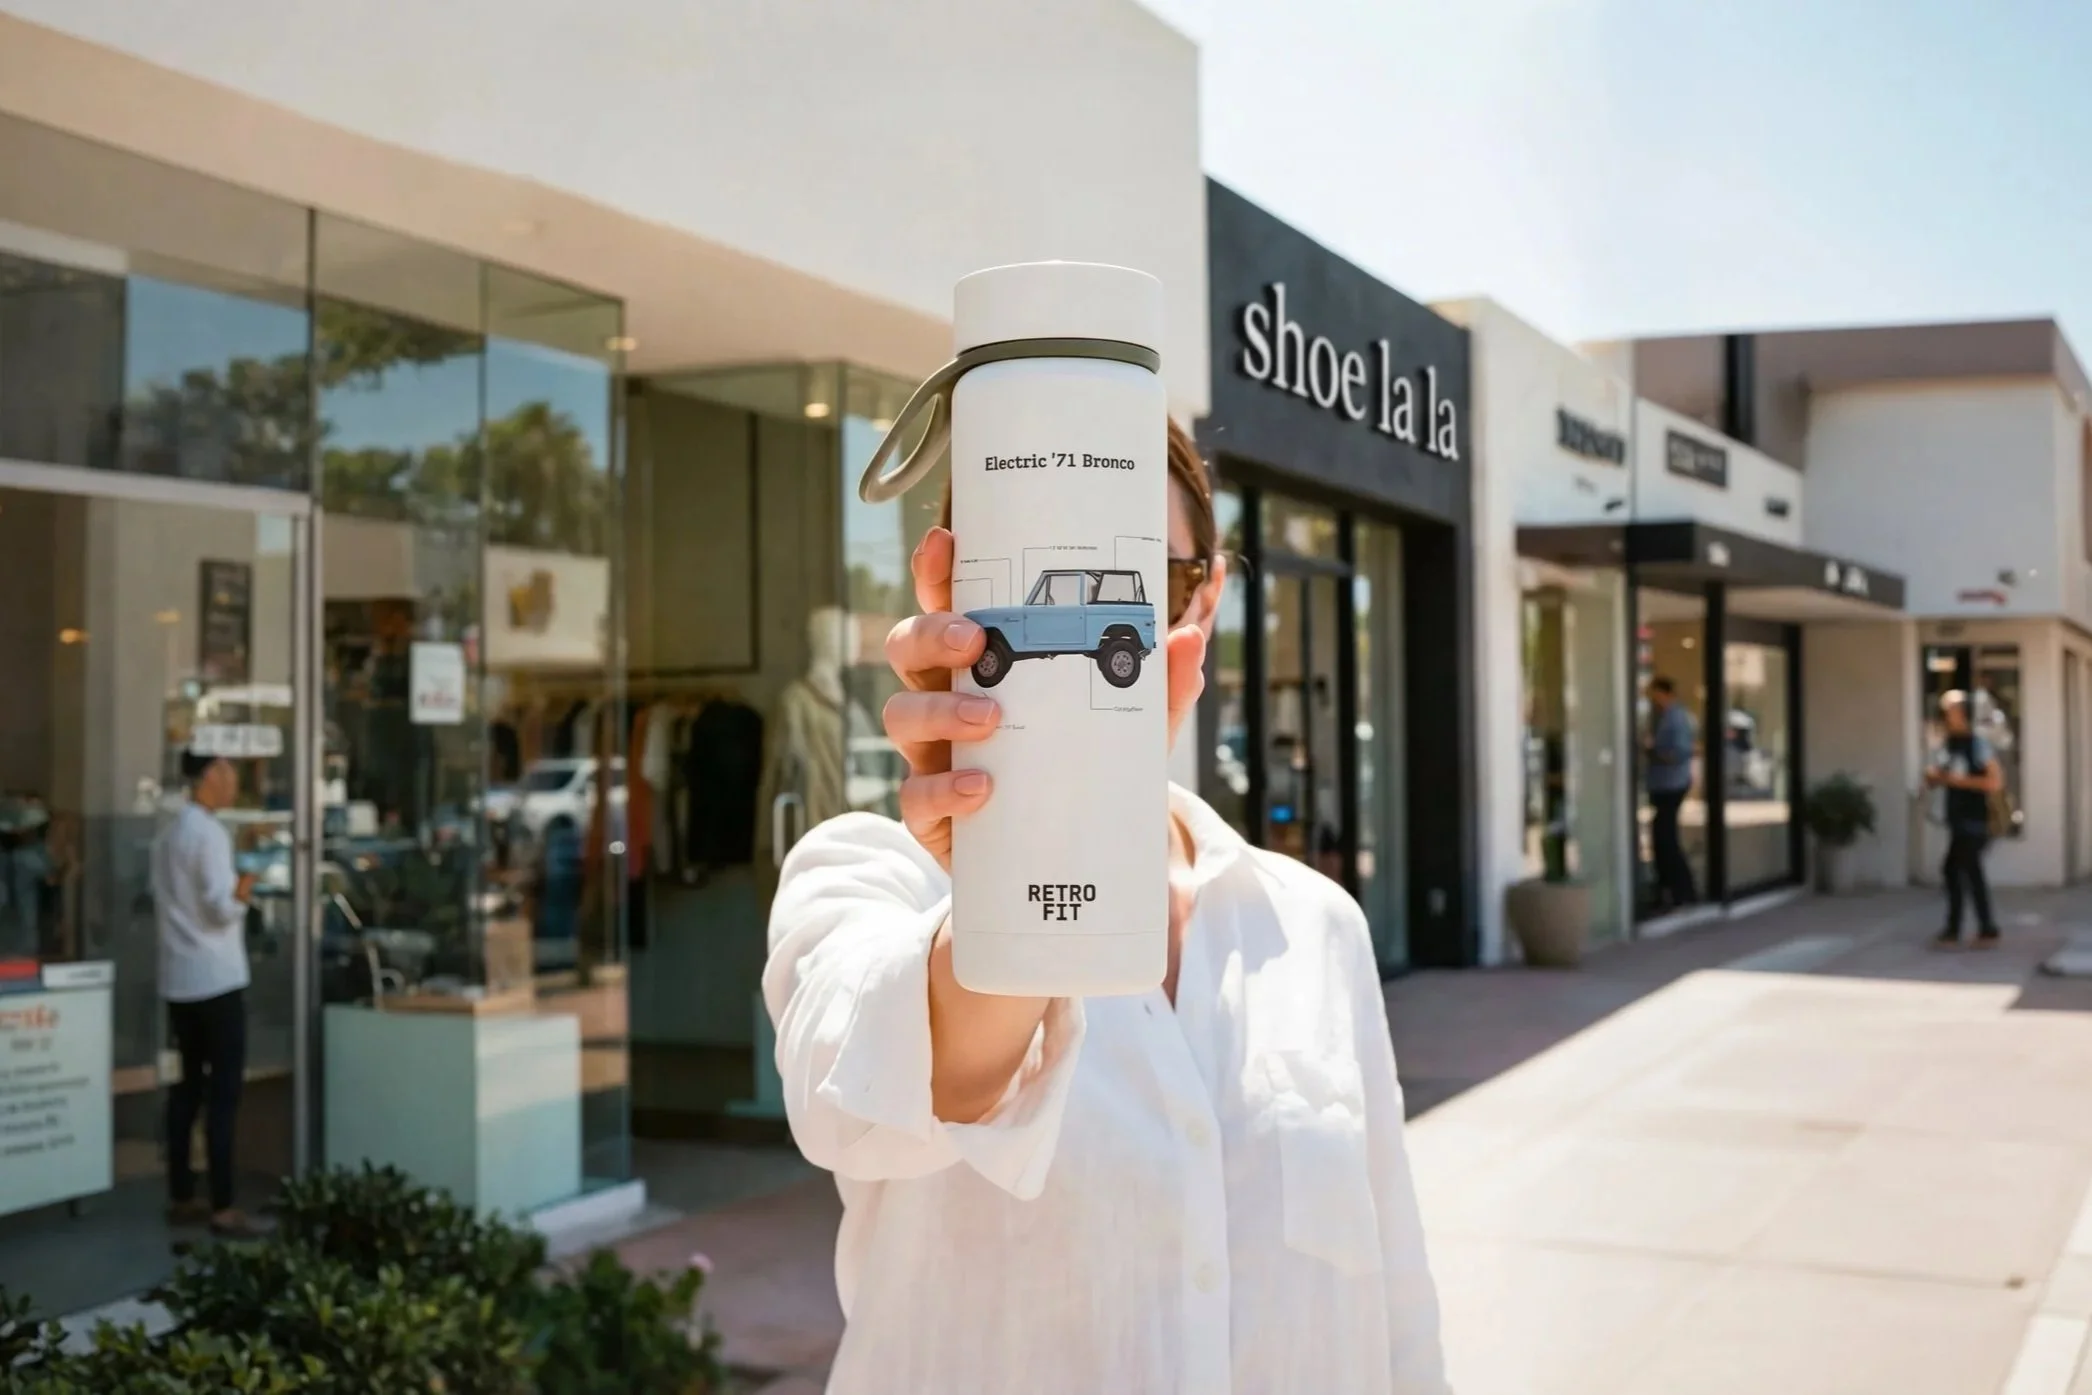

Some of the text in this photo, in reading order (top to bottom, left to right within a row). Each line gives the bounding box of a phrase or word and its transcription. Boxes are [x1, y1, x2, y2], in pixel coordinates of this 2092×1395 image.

[1243, 282, 1367, 421] shoe
[1378, 338, 1417, 444] la
[1427, 365, 1460, 461] la
[985, 452, 1135, 471] Electric '71 Bronco
[1028, 884, 1096, 902] RETRO
[1043, 903, 1082, 921] FIT
